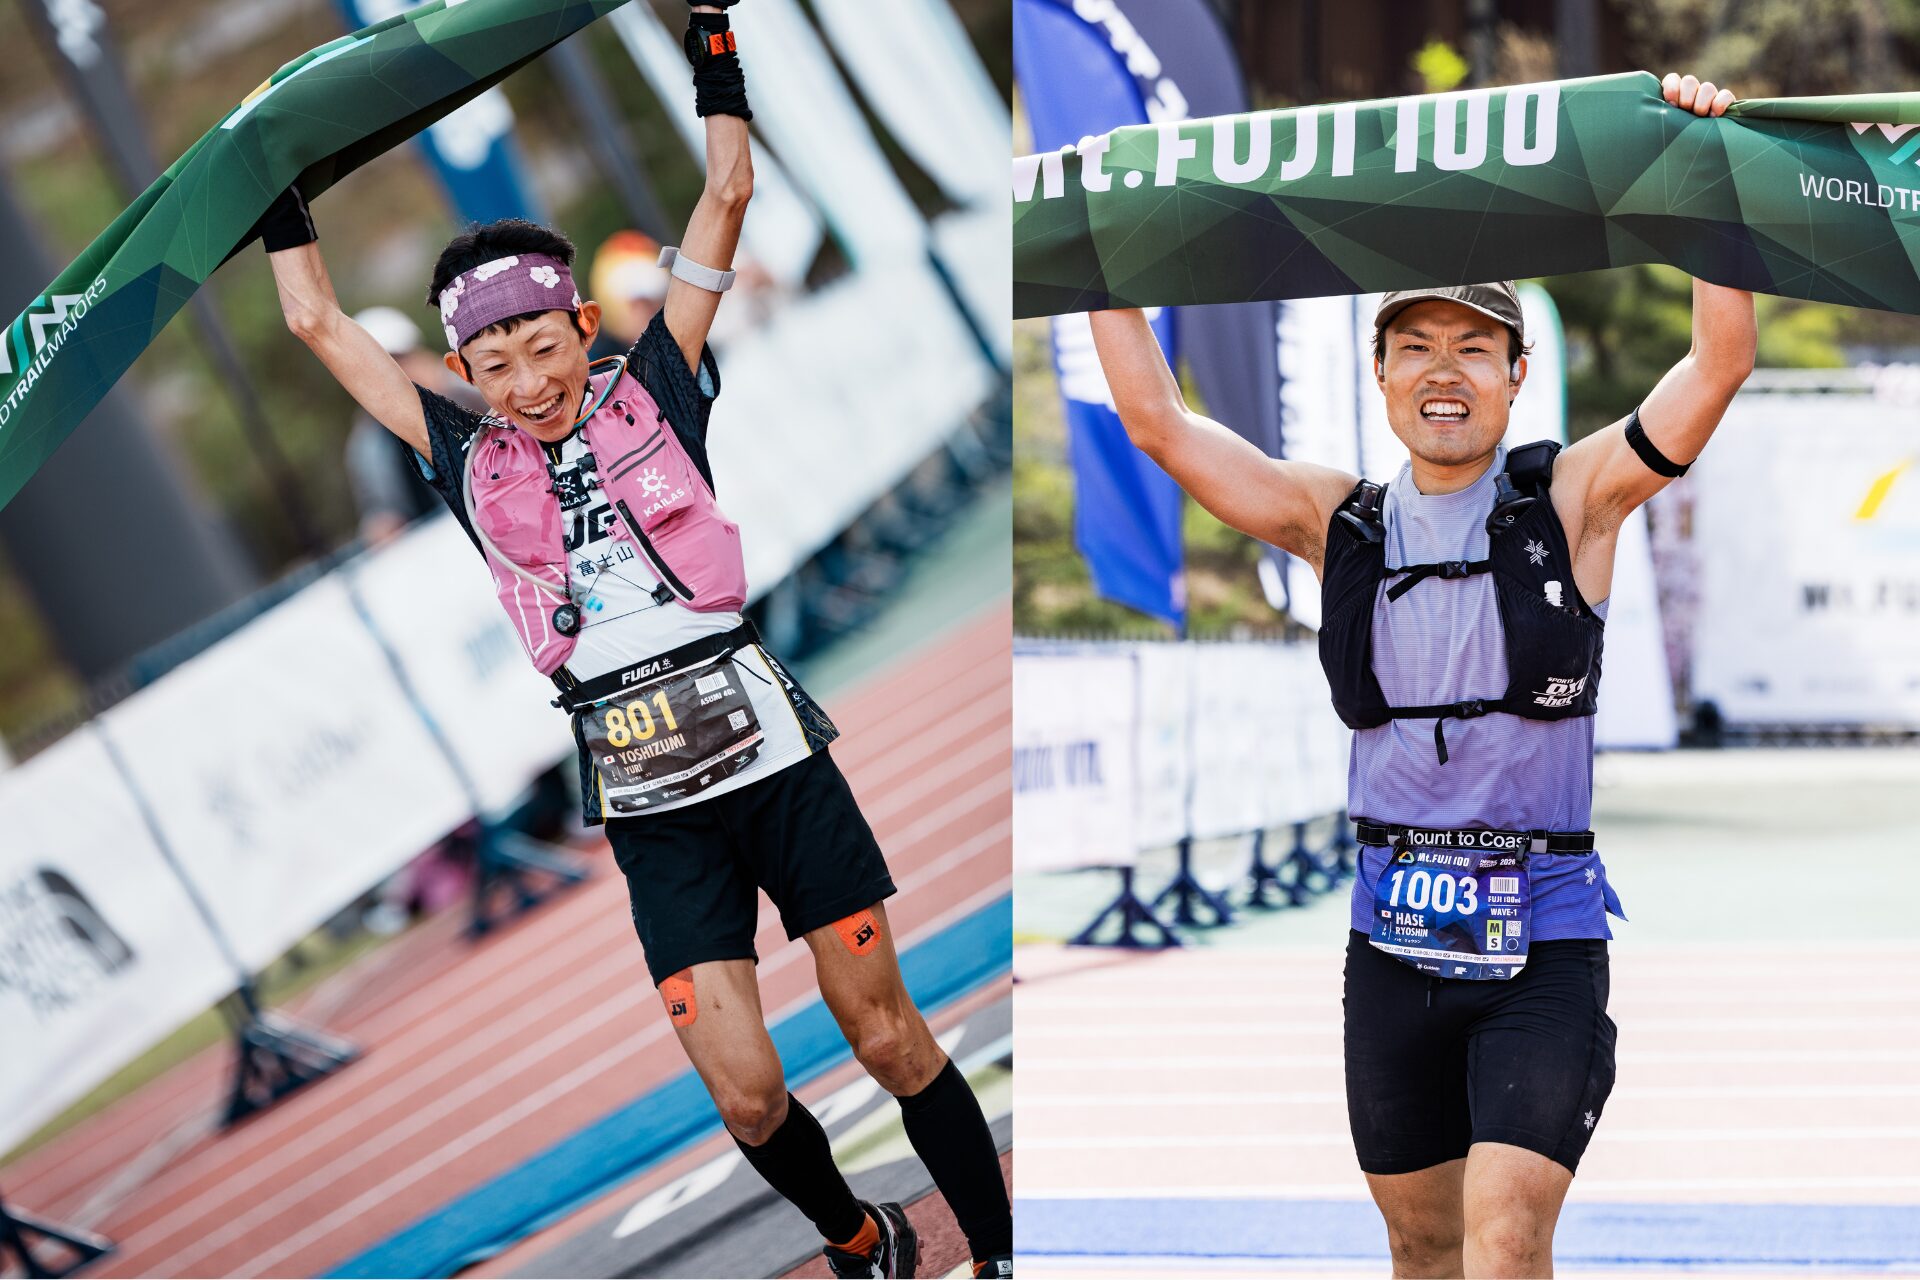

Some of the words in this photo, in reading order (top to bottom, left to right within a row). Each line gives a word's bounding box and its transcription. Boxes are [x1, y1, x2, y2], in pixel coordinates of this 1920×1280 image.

[0, 272, 107, 430] DTRAILMAJORS
[560, 493, 588, 508] AILAS
[643, 487, 686, 518] KAILAS
[576, 546, 635, 577] 富士山
[621, 660, 662, 686] FUGA
[700, 692, 723, 706] ASUMI
[605, 690, 679, 748] 801
[618, 732, 687, 765] YOSHIZUMI
[623, 763, 644, 777] YURI
[1457, 831, 1475, 846] to
[1480, 831, 1530, 849] Coas
[1417, 852, 1452, 865] Mt.FUJI
[1453, 856, 1470, 867] 100
[1389, 870, 1478, 915] 1003
[1487, 895, 1503, 903] FUJI
[1395, 911, 1425, 928] HASE
[1490, 907, 1518, 916] WAVE-1
[855, 924, 875, 947] KT
[1395, 926, 1429, 938] RYOSHIN
[1489, 922, 1500, 934] M
[1490, 937, 1498, 948] S
[671, 1002, 687, 1016] KT
